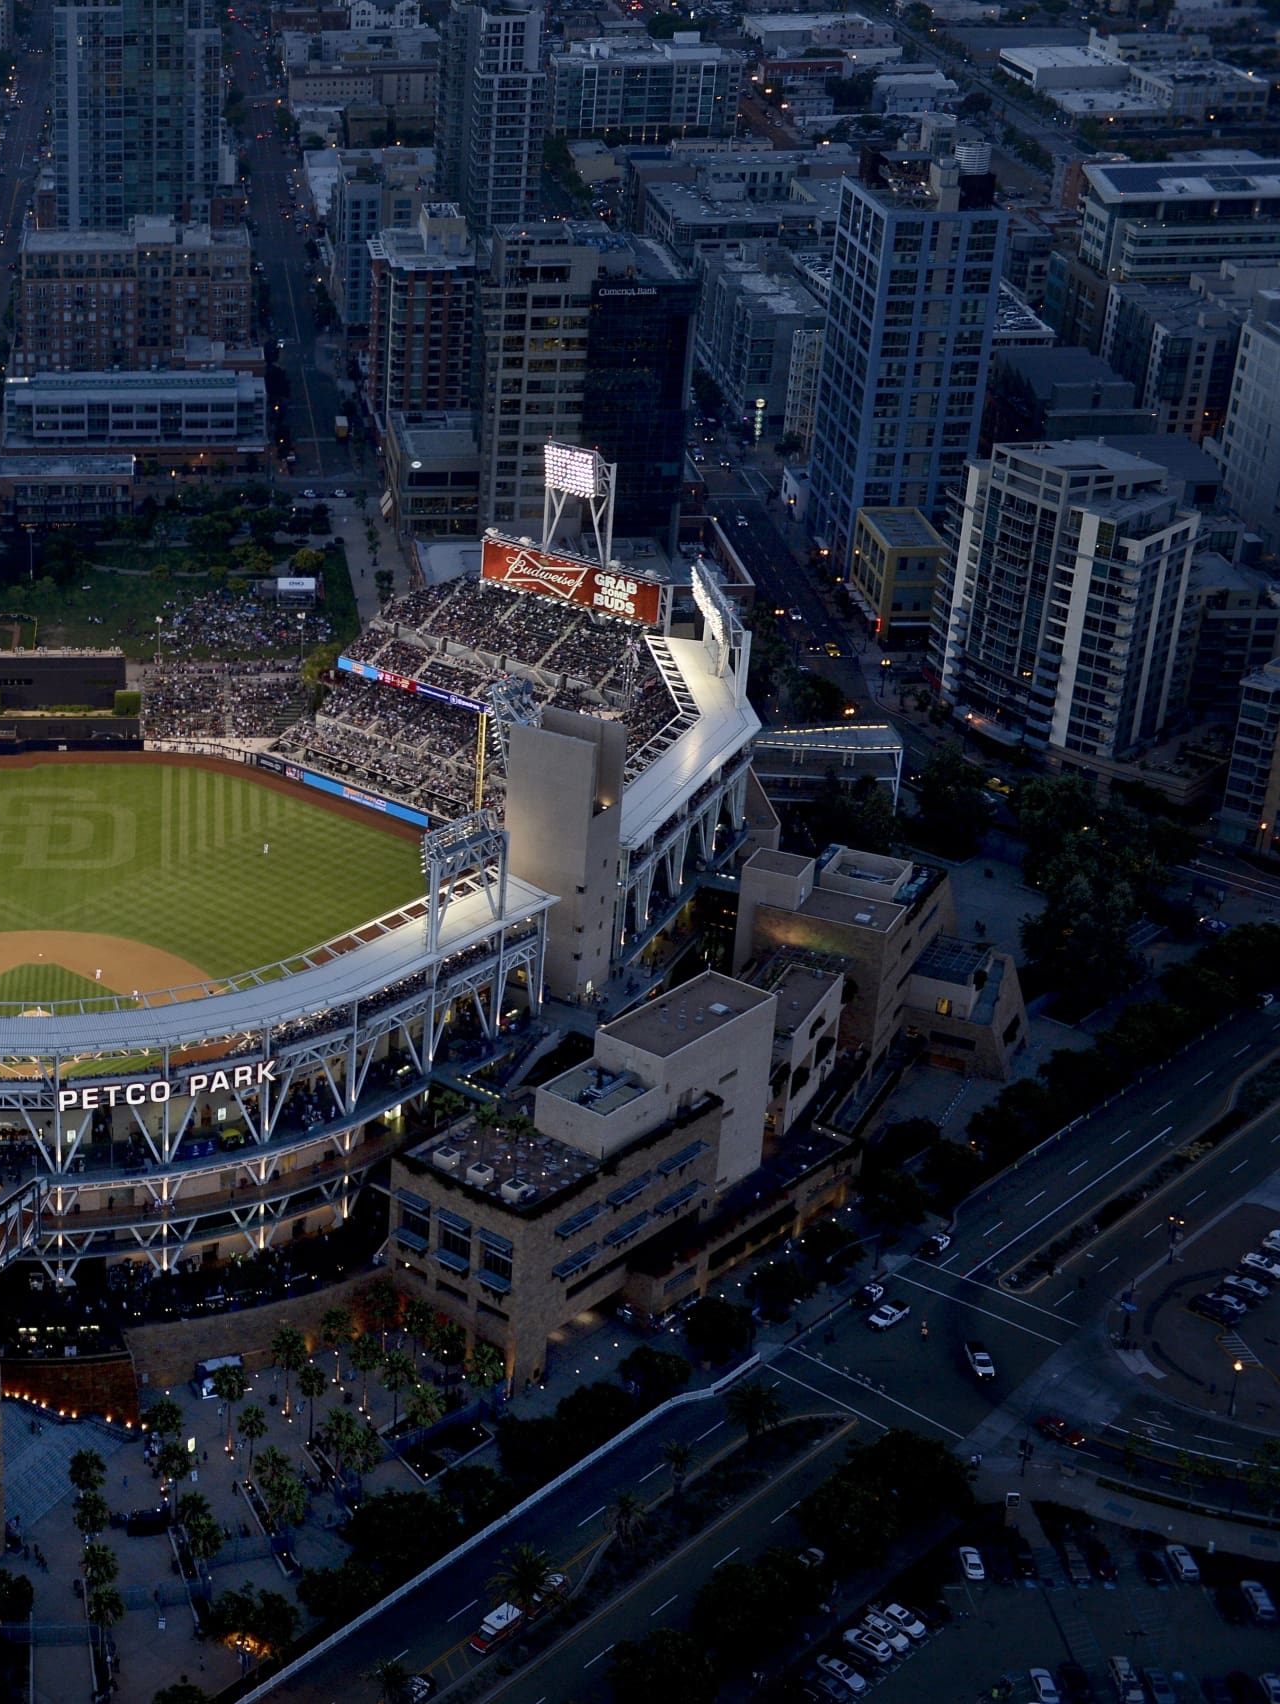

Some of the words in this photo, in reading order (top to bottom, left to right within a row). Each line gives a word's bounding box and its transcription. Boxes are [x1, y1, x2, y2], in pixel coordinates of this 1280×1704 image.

[637, 287, 657, 295] Bank
[505, 556, 583, 588] Budweiser
[594, 573, 638, 595] GRAB
[601, 587, 630, 600] SOME
[593, 592, 636, 615] BUDS
[58, 1081, 170, 1112] PETCO
[190, 1060, 276, 1097] PARK
